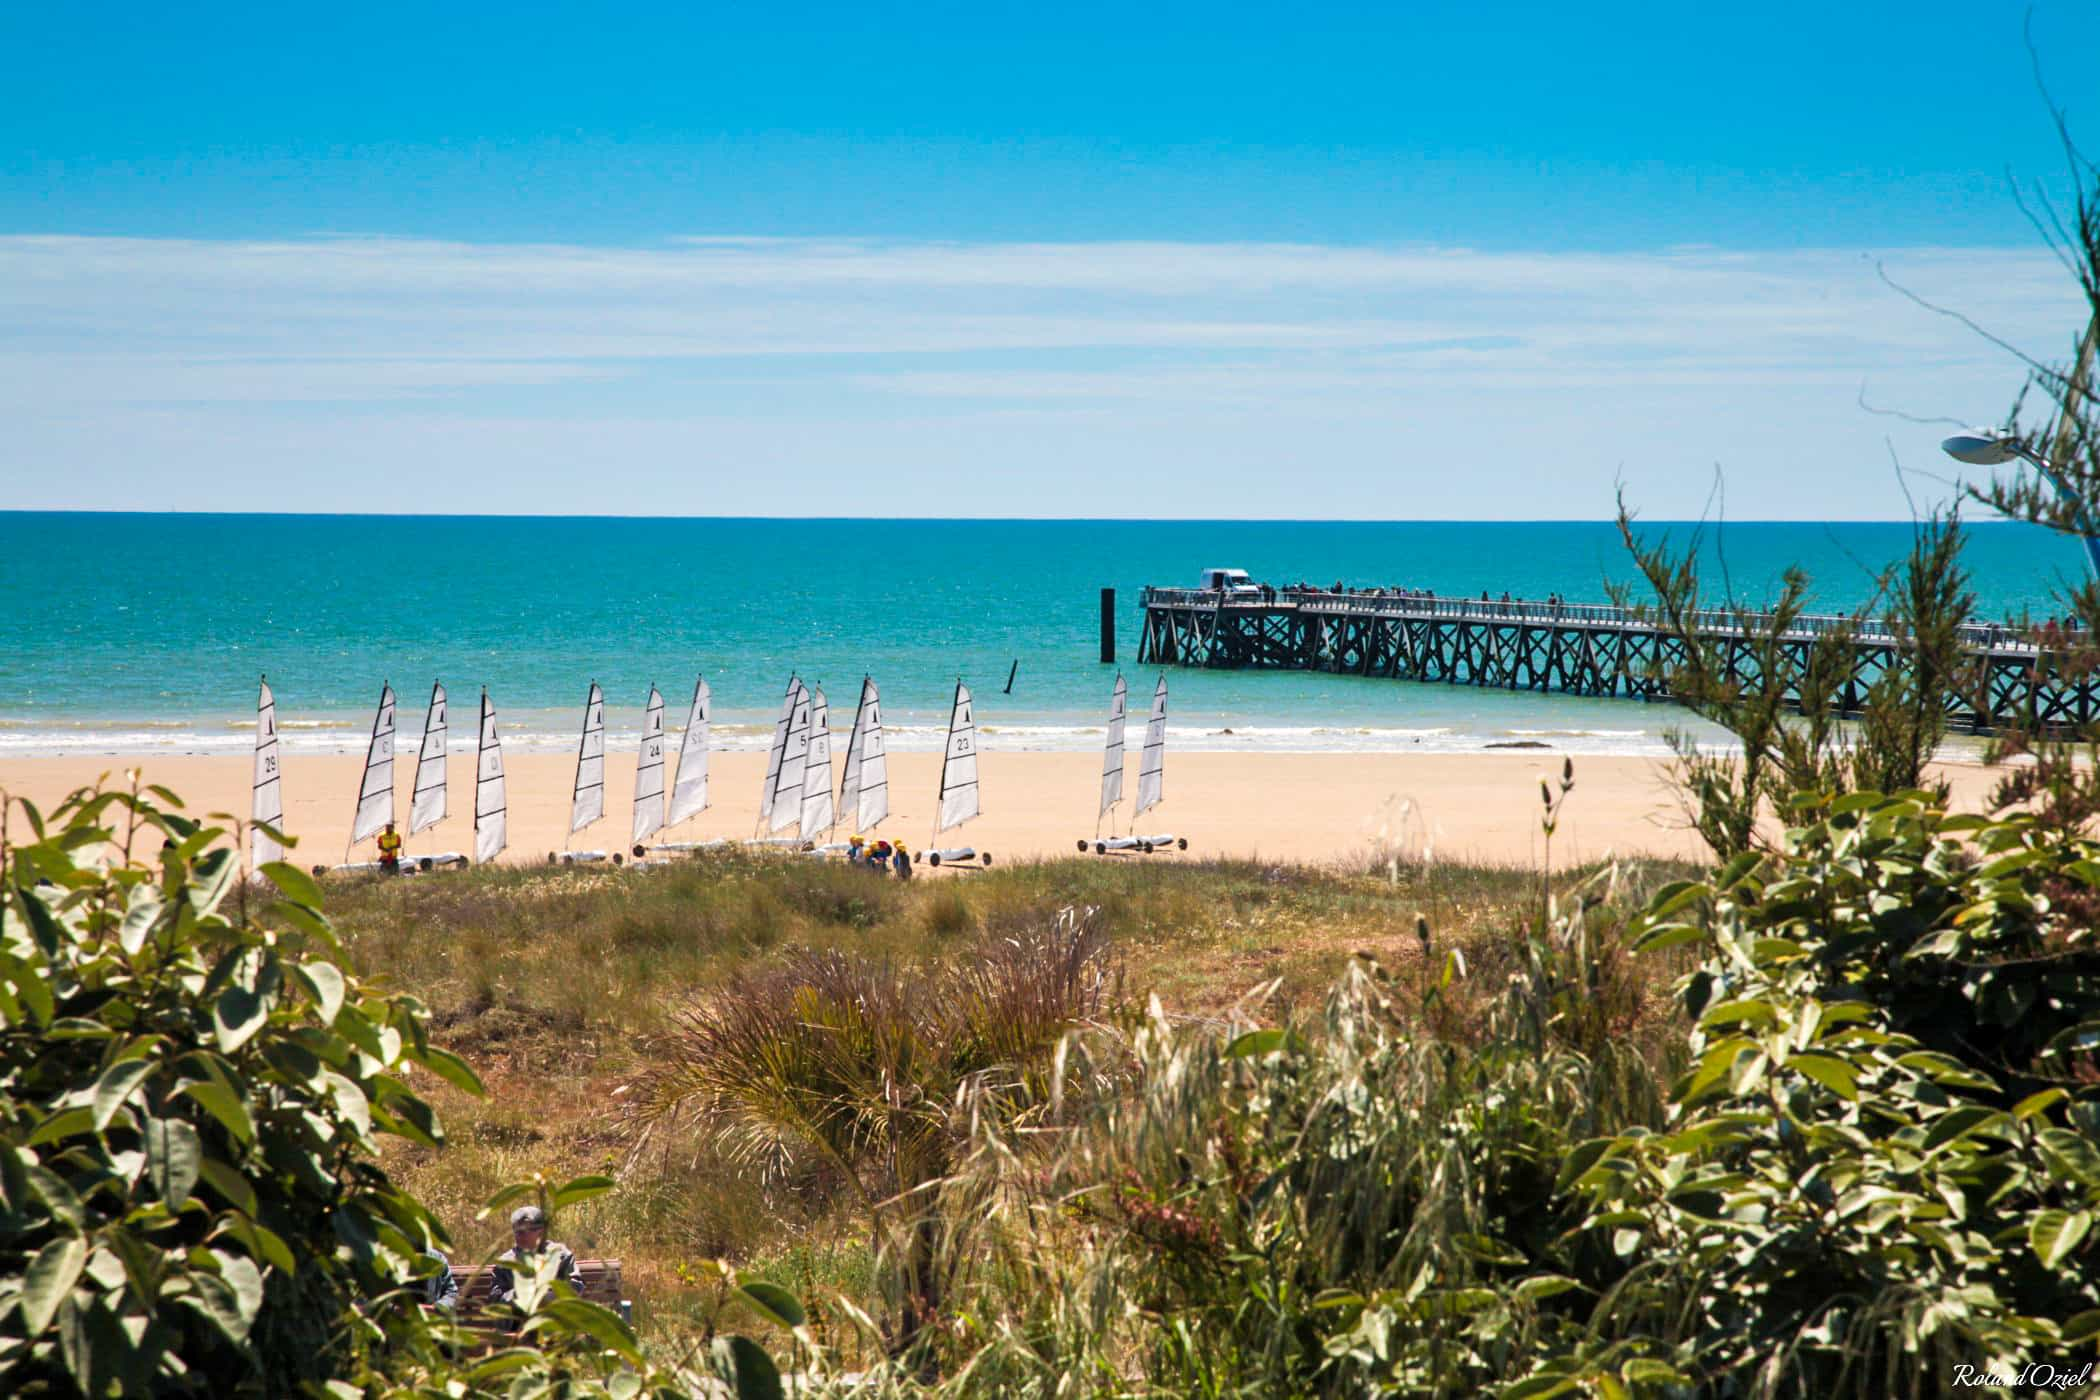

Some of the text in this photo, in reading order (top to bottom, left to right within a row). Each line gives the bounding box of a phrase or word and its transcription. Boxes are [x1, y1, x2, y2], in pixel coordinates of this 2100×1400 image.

[800, 735, 807, 747] 5
[957, 737, 969, 751] 23
[650, 744, 661, 757] 24
[265, 755, 276, 773] 29
